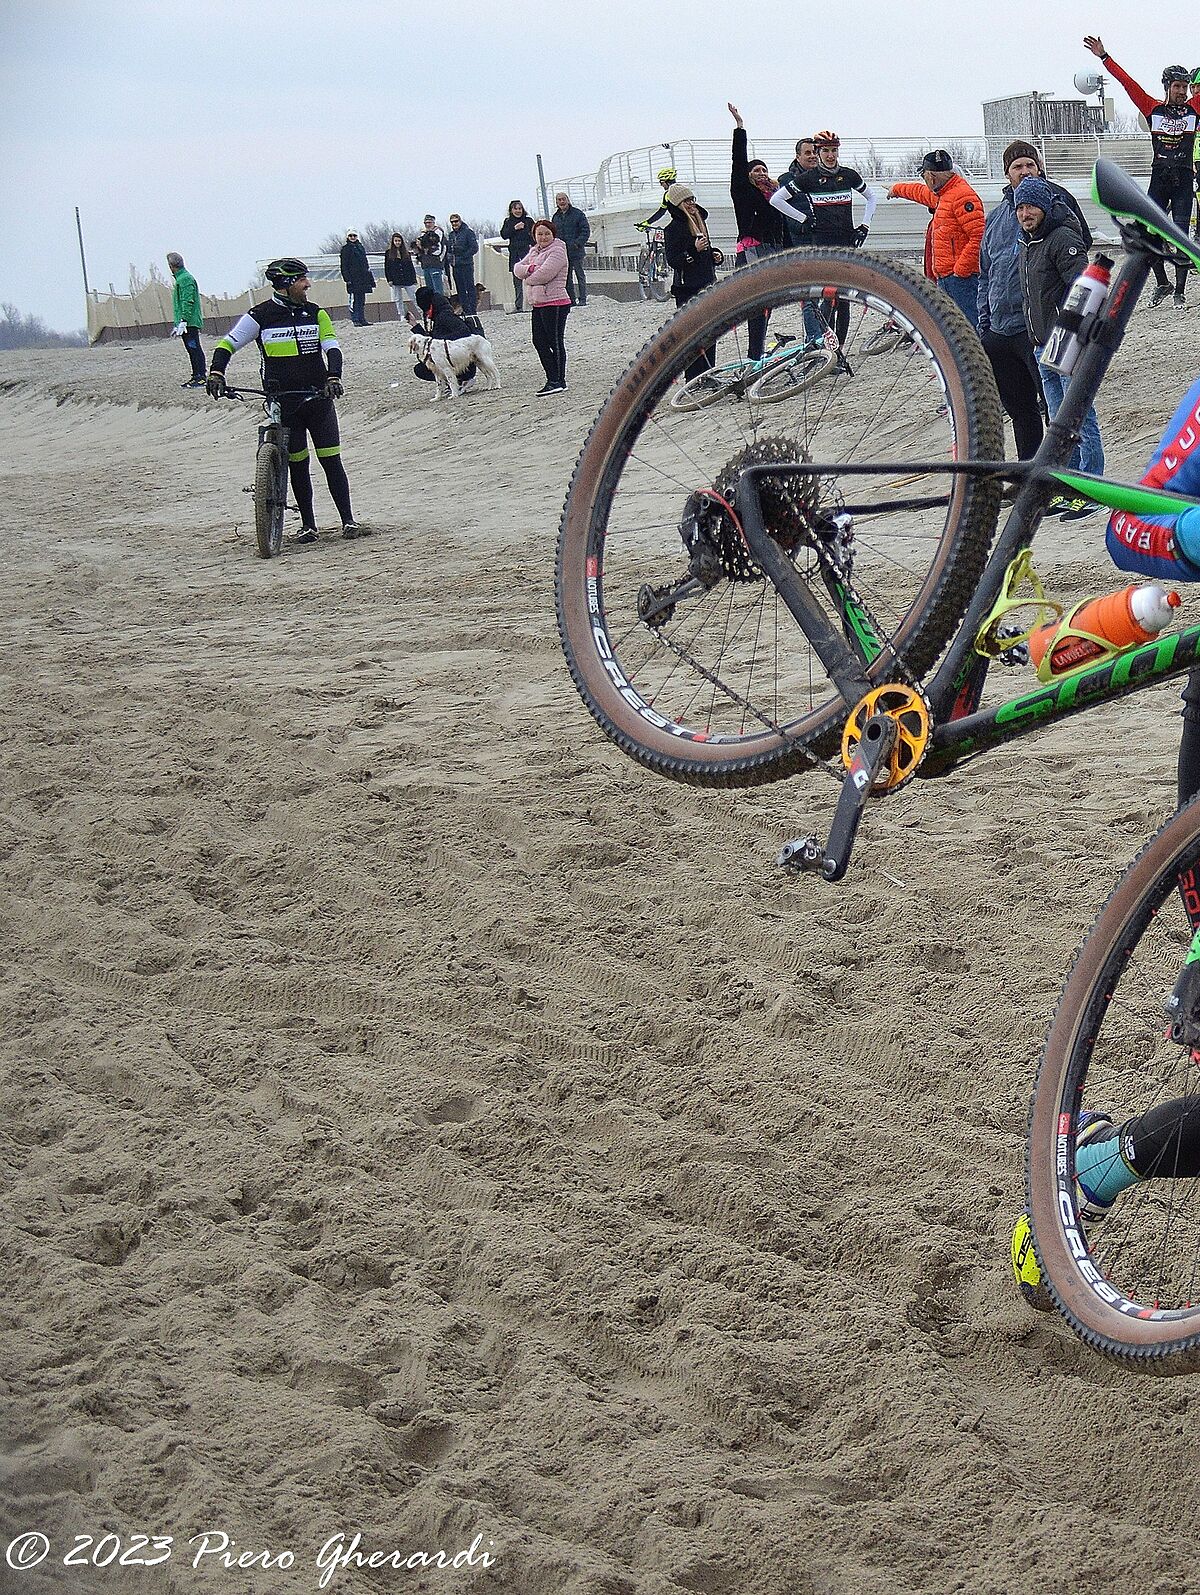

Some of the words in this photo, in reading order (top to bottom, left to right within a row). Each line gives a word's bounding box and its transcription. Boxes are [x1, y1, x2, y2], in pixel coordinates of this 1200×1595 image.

[593, 627, 693, 738] CREST
[1057, 1134, 1067, 1176] NOTUBES
[1058, 1190, 1144, 1313] CREST
